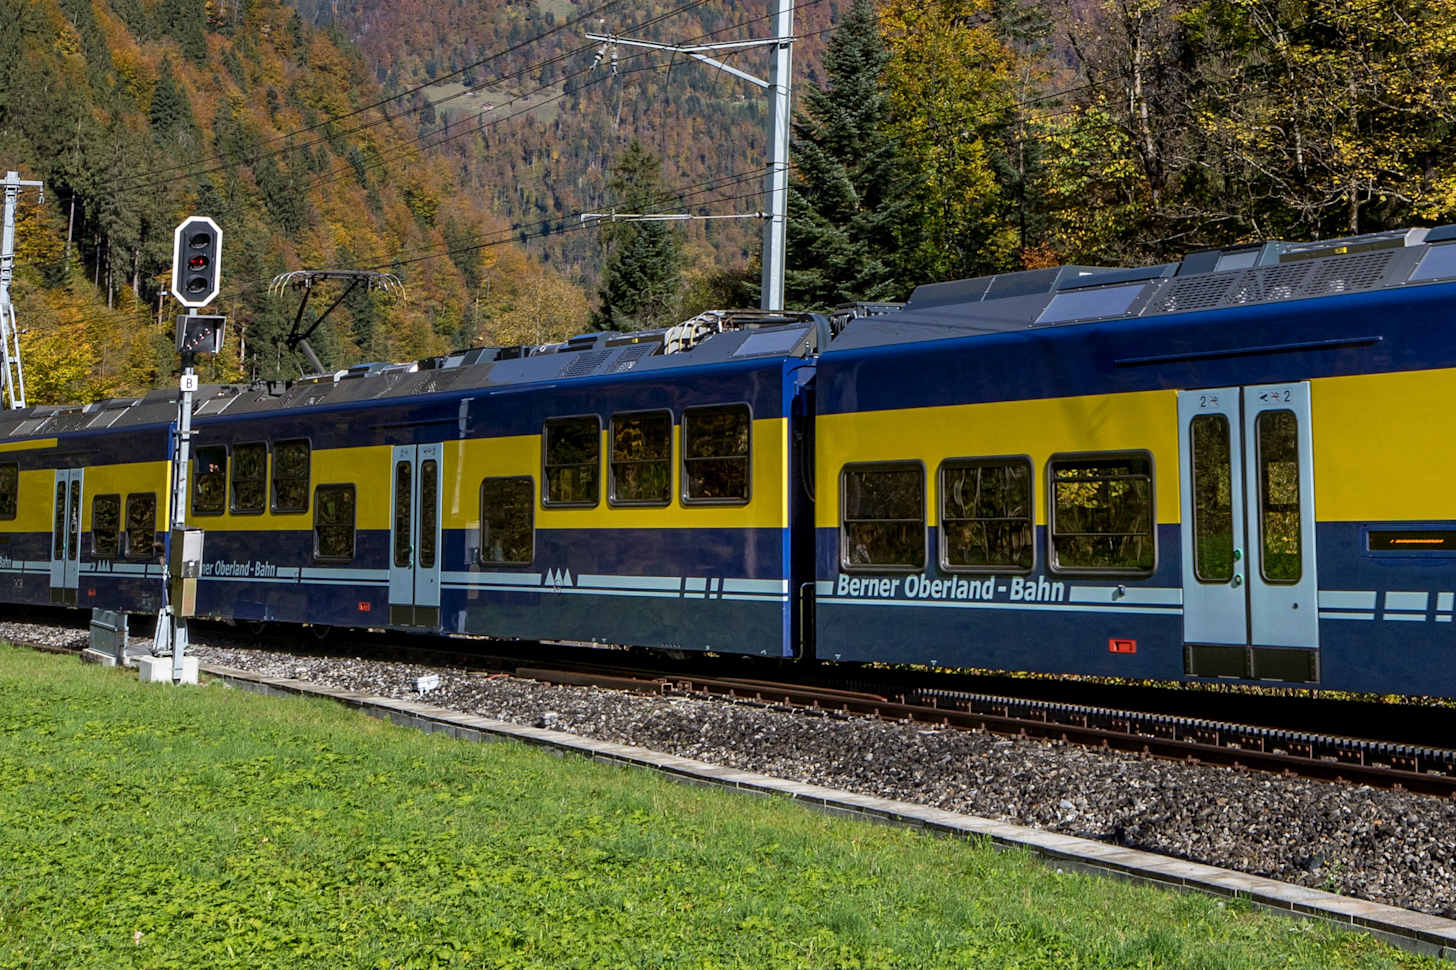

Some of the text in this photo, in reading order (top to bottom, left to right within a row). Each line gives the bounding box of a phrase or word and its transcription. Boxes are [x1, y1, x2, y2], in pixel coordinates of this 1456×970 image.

[186, 377, 193, 389] B
[1284, 390, 1291, 402] 2
[836, 572, 900, 598] Berner
